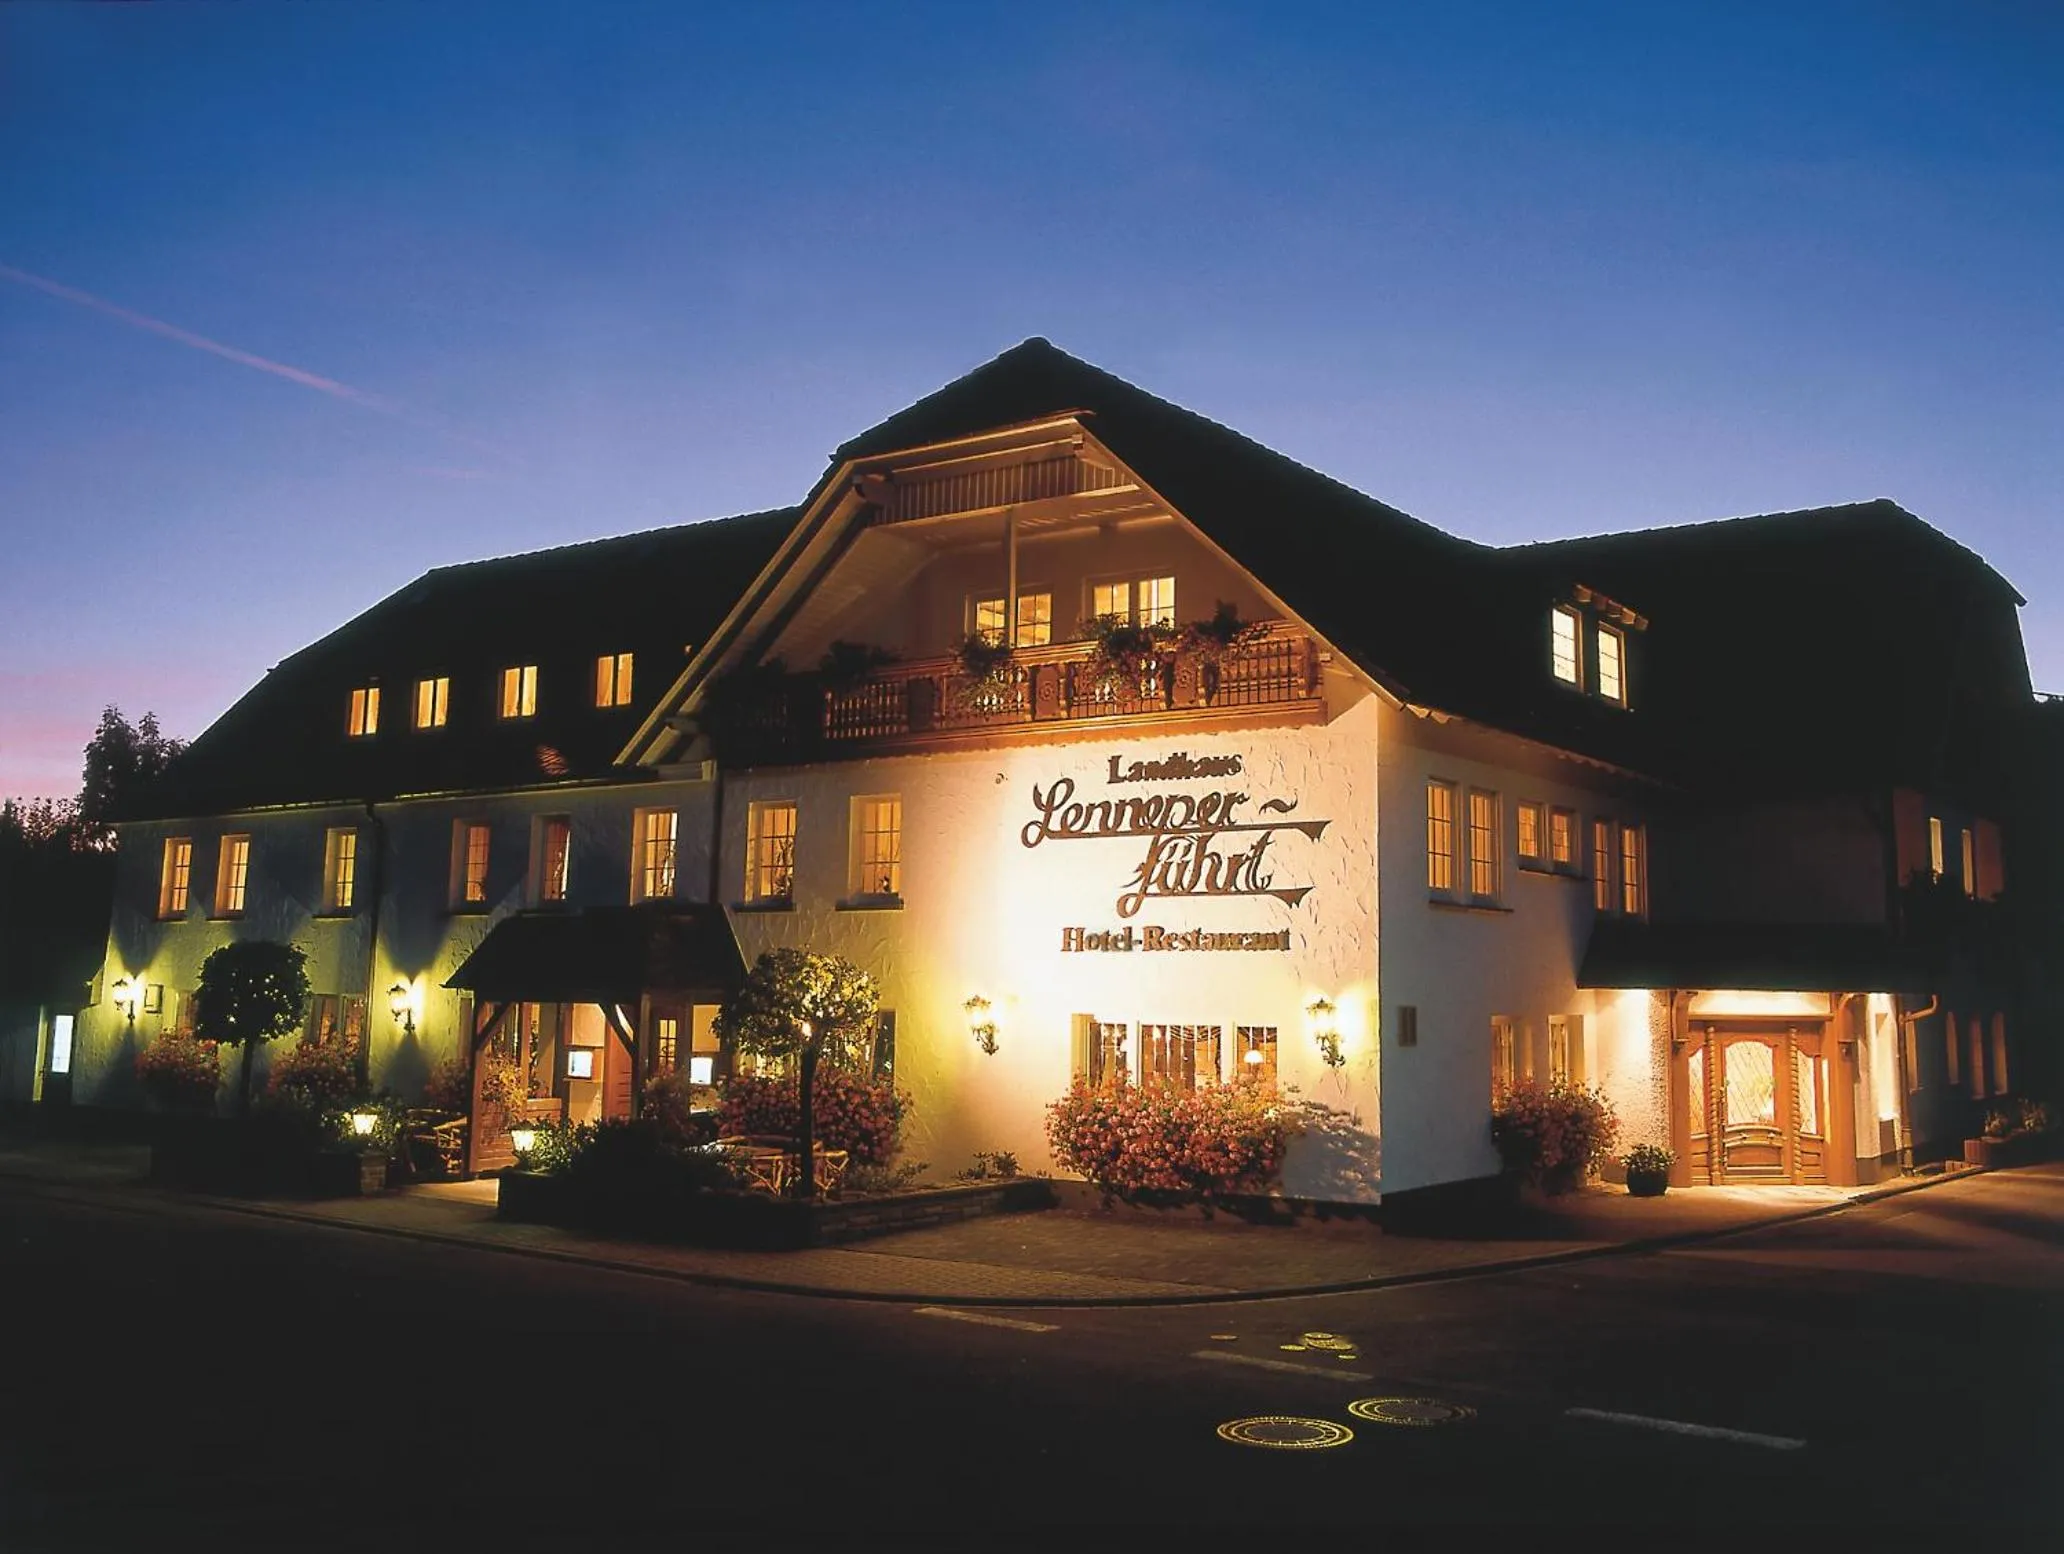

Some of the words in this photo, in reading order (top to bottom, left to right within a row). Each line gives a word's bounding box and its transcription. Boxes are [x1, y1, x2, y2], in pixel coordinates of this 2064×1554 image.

[1107, 753, 1243, 784] Landhaus
[1021, 777, 1250, 848] Lenneper
[1061, 925, 1291, 952] Hotel-Restaurant
